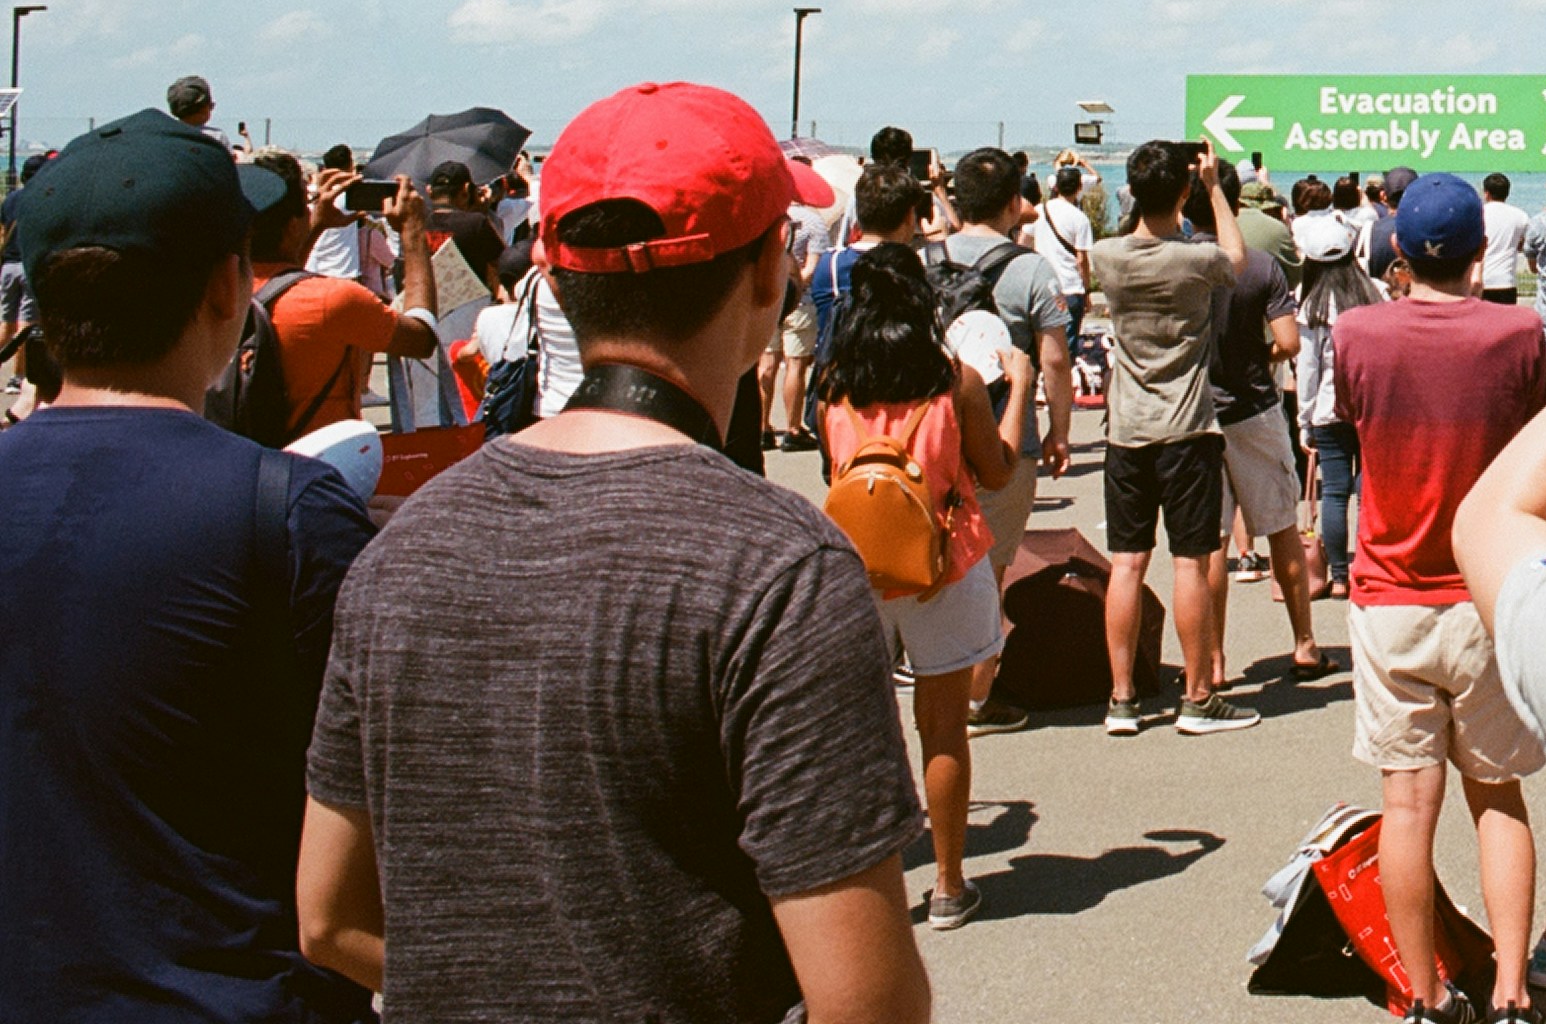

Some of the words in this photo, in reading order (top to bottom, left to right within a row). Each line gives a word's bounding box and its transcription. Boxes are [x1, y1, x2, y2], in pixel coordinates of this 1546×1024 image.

[1319, 85, 1497, 115] Evacuation
[1283, 119, 1442, 159] Assembly
[1448, 122, 1527, 151] Area
